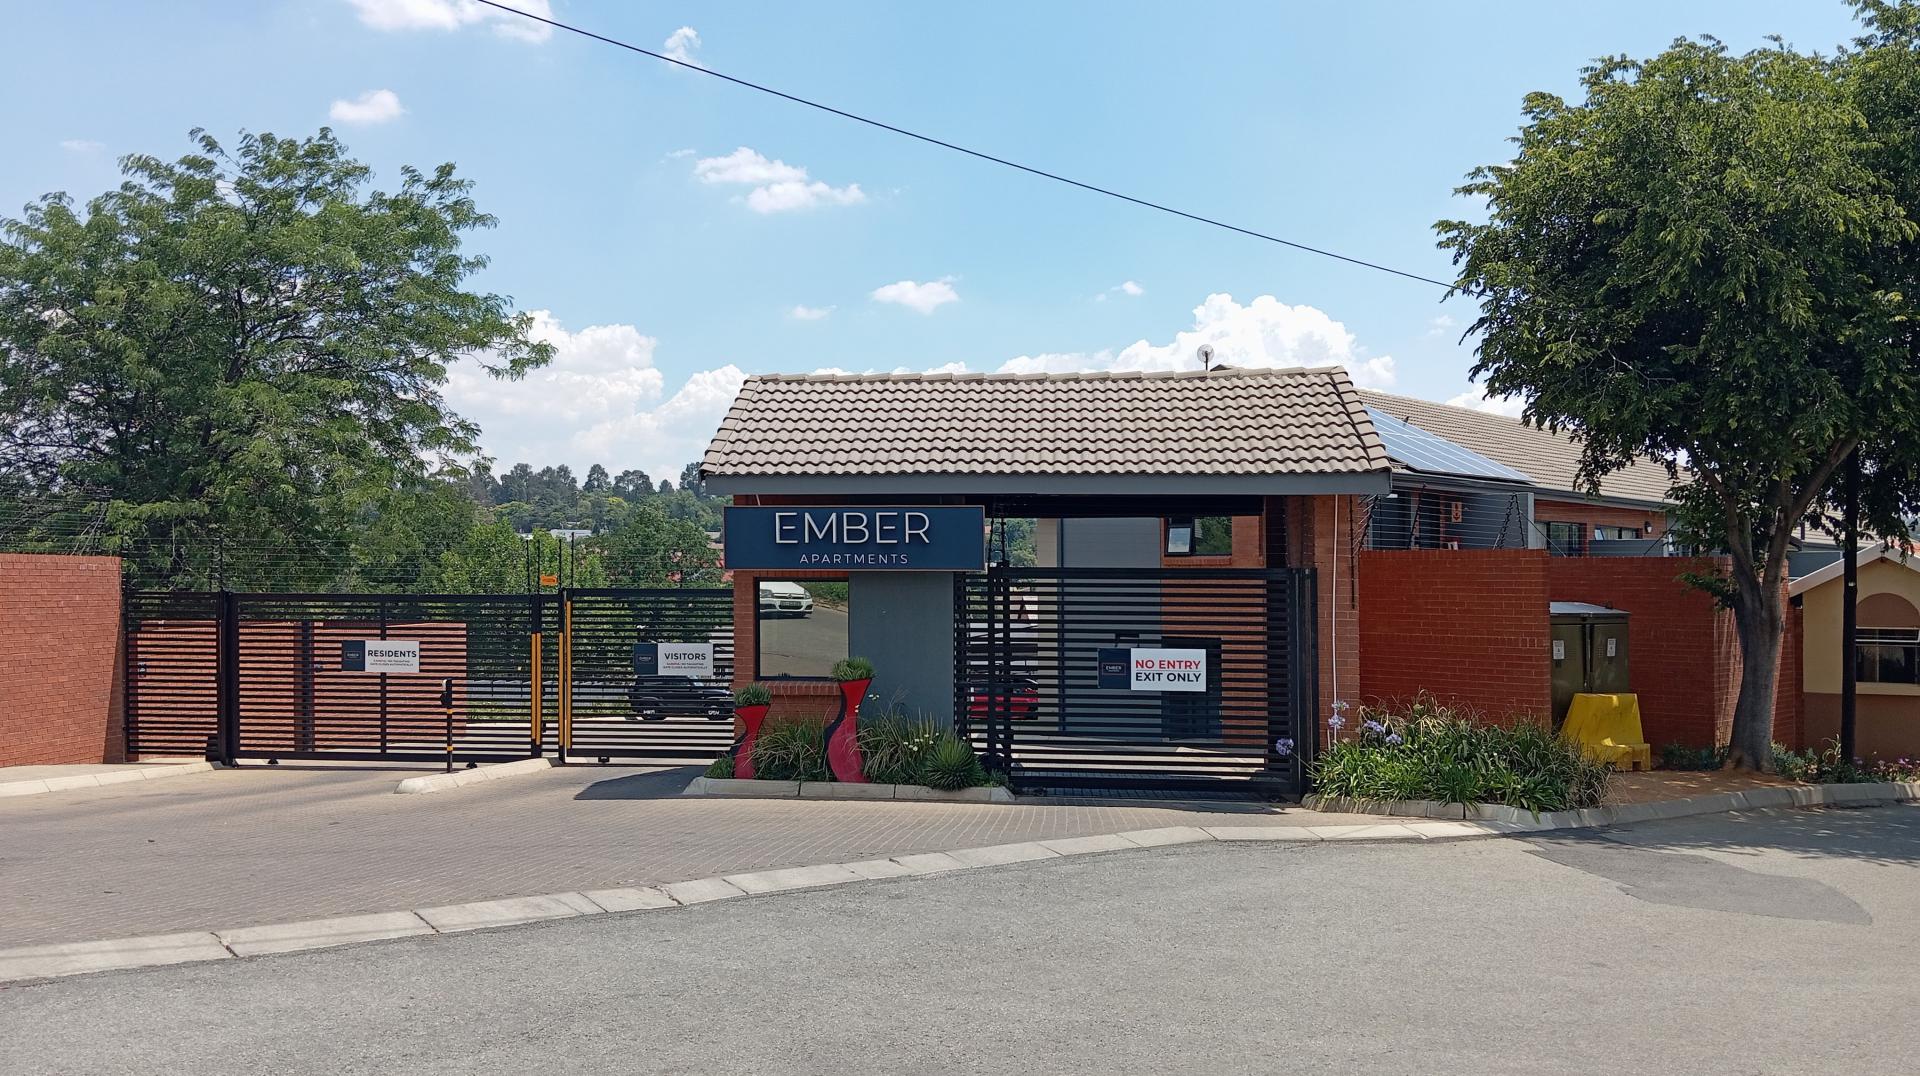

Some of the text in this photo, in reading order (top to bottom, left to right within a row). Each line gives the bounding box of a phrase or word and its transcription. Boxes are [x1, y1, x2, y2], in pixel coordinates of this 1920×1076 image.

[775, 512, 930, 544] EMBER
[799, 554, 908, 564] APARTMENTS
[367, 649, 417, 658] RESIDENTS
[664, 652, 707, 660] VISITORS
[1135, 660, 1201, 670] NO ENTRY
[1135, 672, 1202, 682] EXIT ONLY
